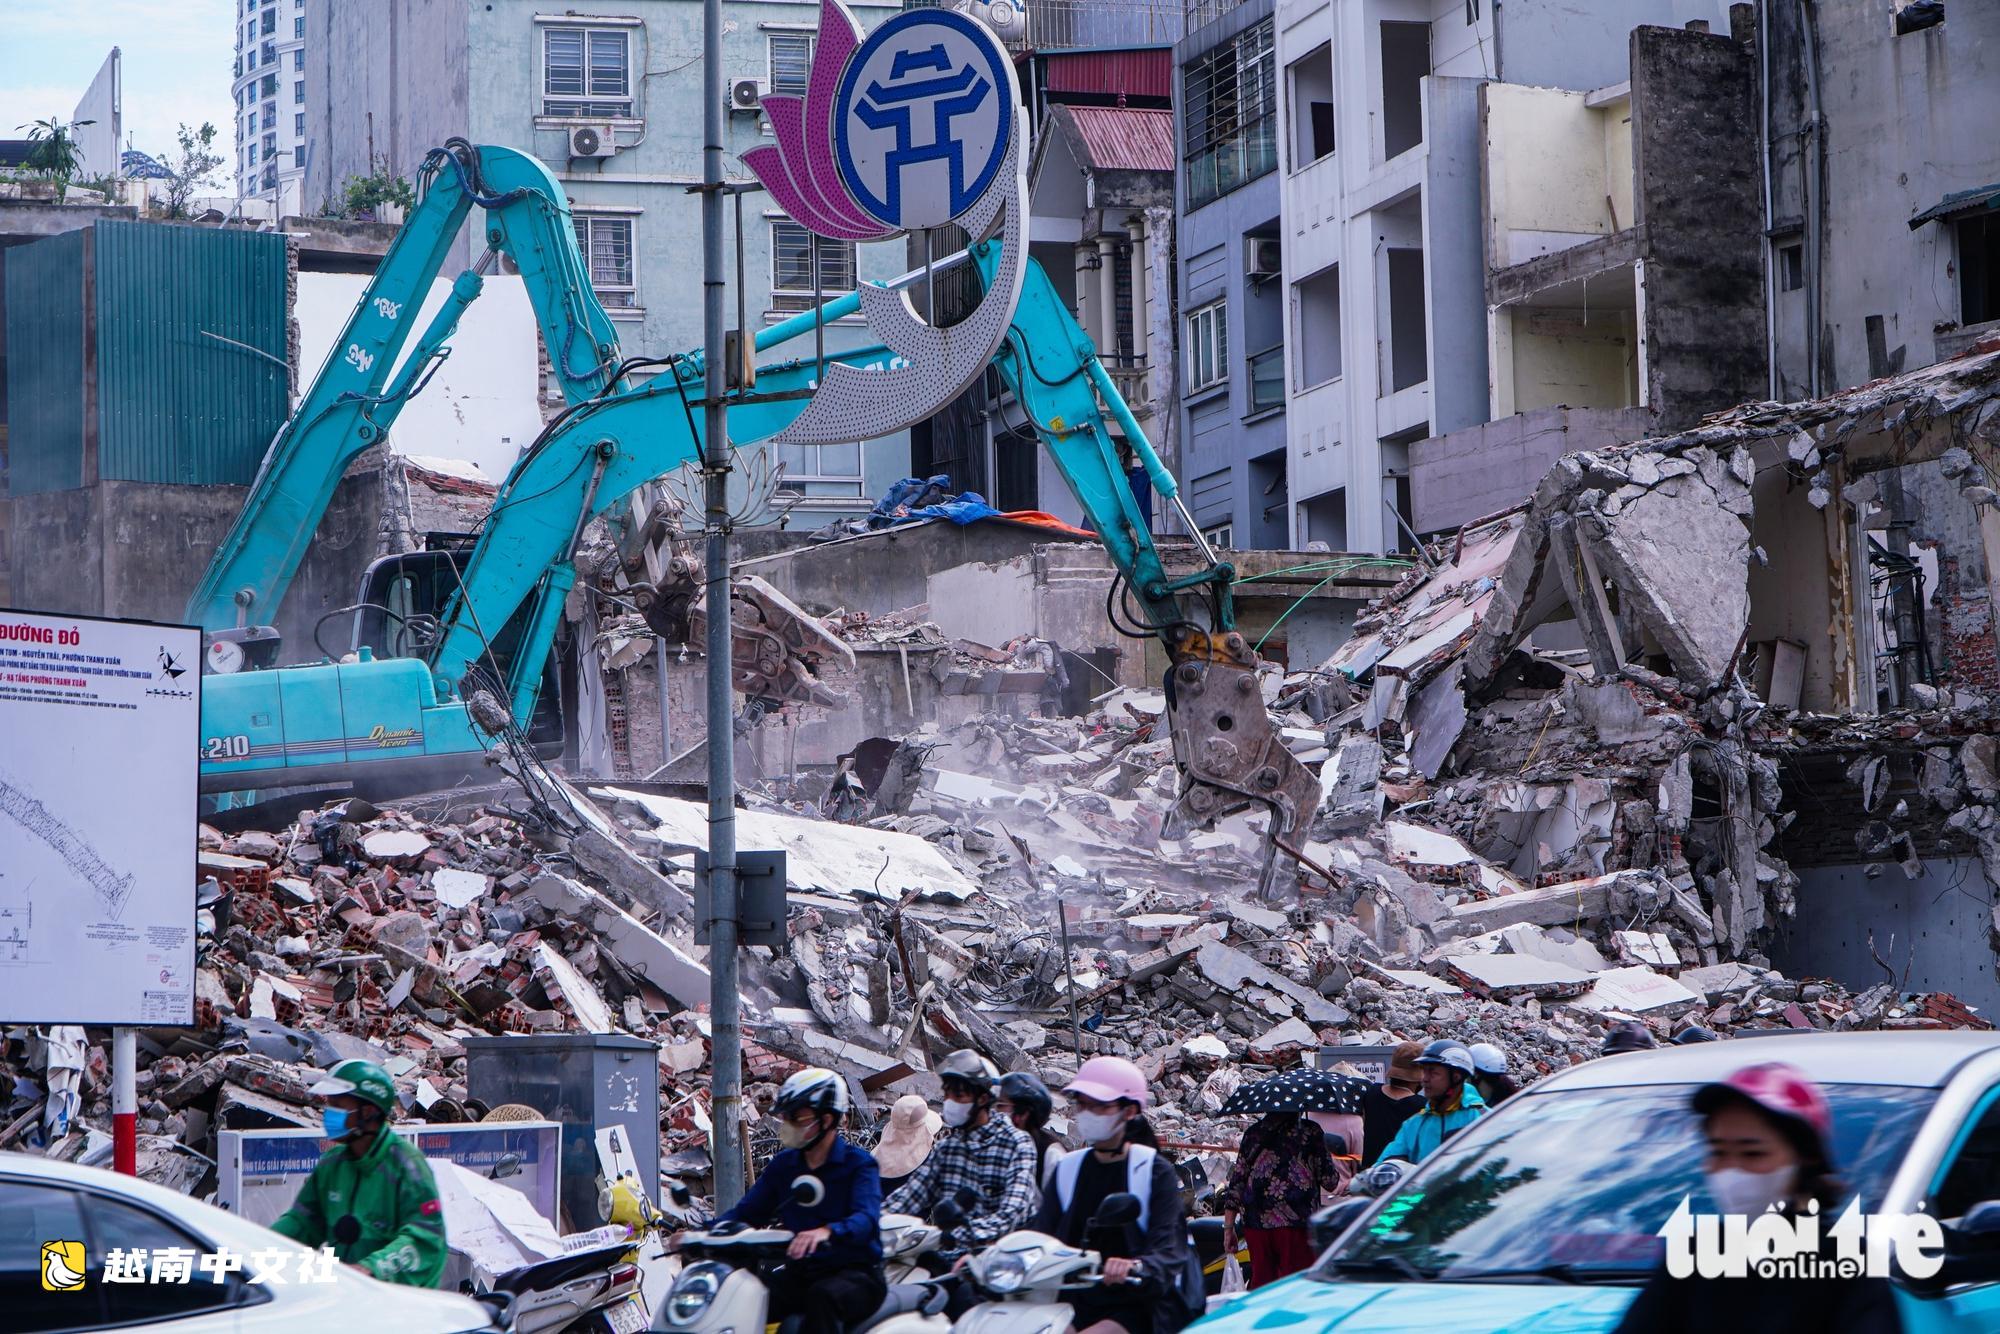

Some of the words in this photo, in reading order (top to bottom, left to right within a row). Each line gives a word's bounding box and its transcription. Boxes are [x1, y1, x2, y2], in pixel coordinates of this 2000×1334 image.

[58, 626, 80, 646] ĐỎ
[86, 655, 104, 664] THANH
[105, 656, 121, 666] XUÂN
[53, 677, 71, 686] THANH
[72, 678, 87, 688] XUÂN
[368, 724, 415, 741] Dynamic
[377, 738, 409, 749] Acera
